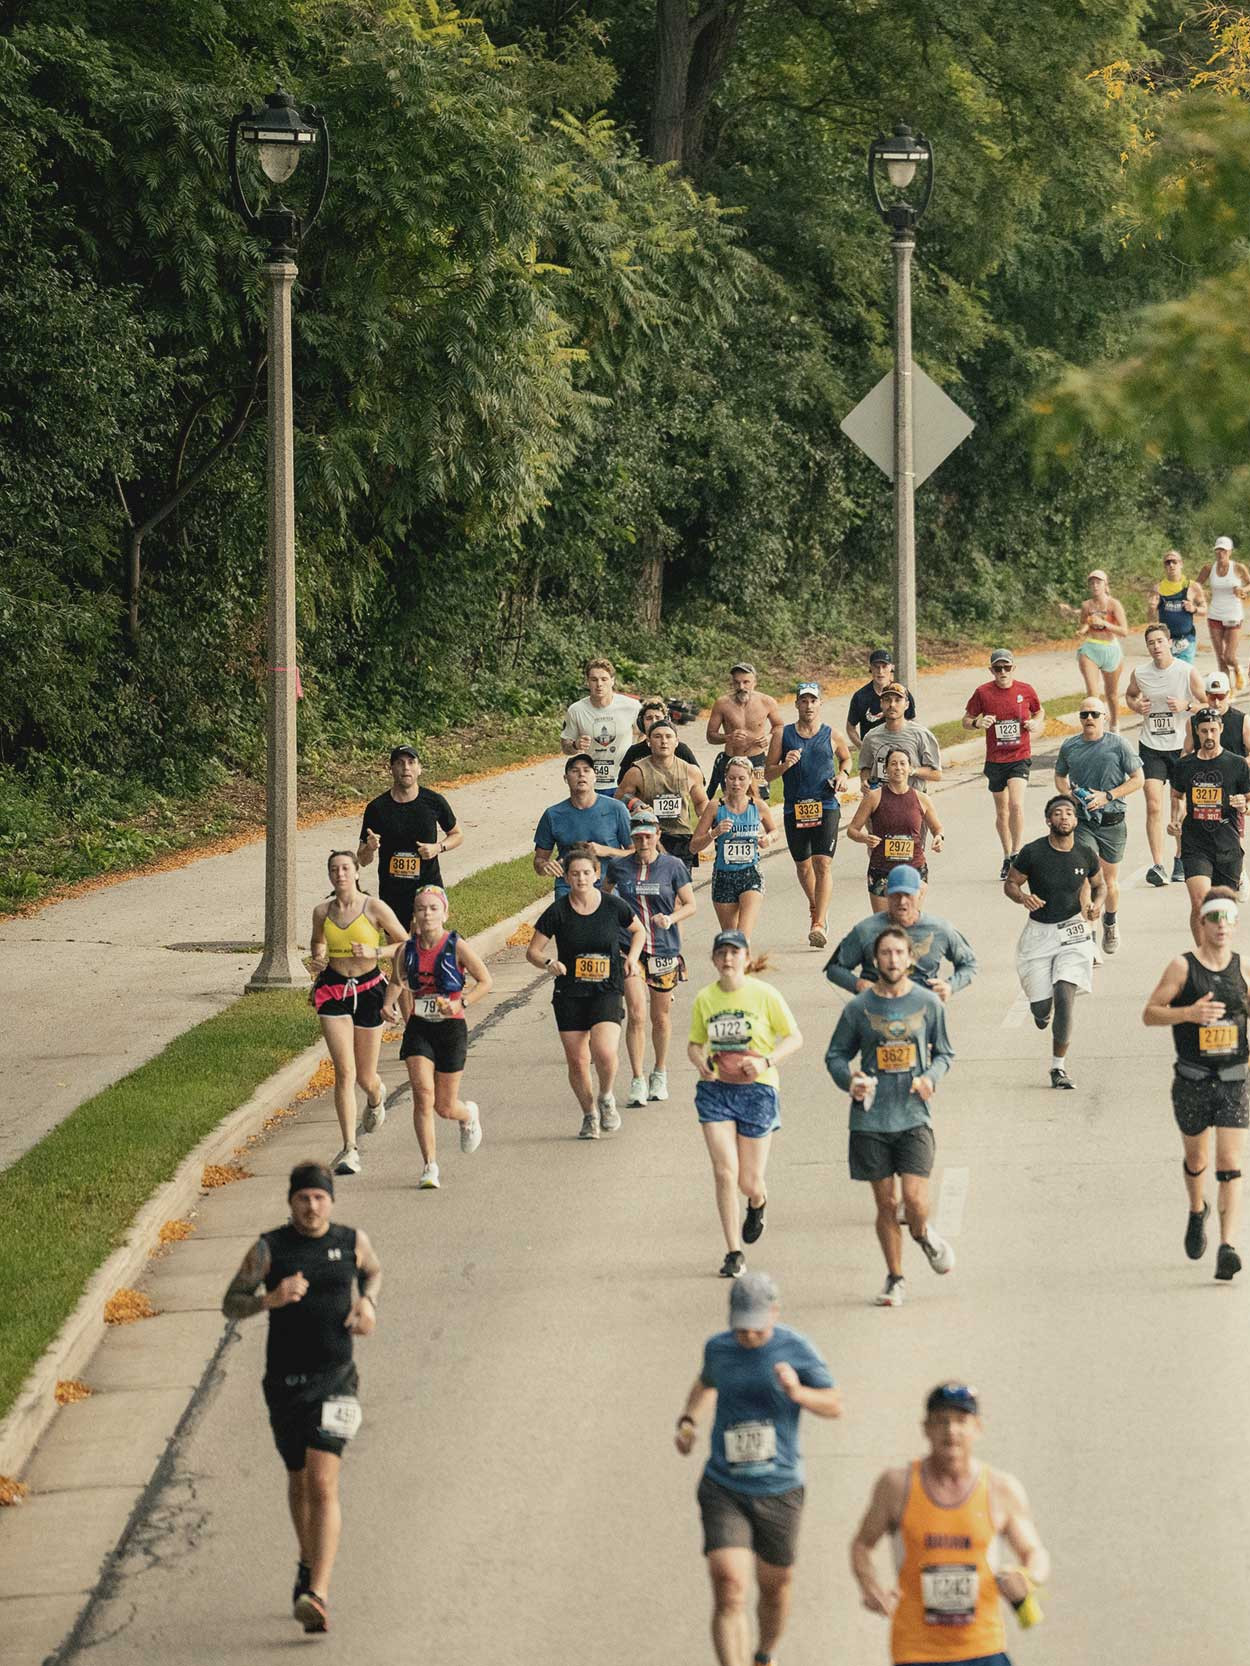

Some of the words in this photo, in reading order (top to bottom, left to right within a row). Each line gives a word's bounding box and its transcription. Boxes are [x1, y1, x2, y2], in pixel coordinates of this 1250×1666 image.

[1000, 724, 1018, 735] 1223
[1153, 719, 1171, 728] 1071
[1196, 789, 1218, 801] 3217
[659, 799, 680, 811] 1294
[798, 804, 819, 815] 3323
[728, 845, 751, 856] 2113
[889, 841, 911, 853] 2972
[393, 859, 416, 871] 3813
[580, 960, 606, 974] 3610
[714, 1021, 741, 1037] 1722
